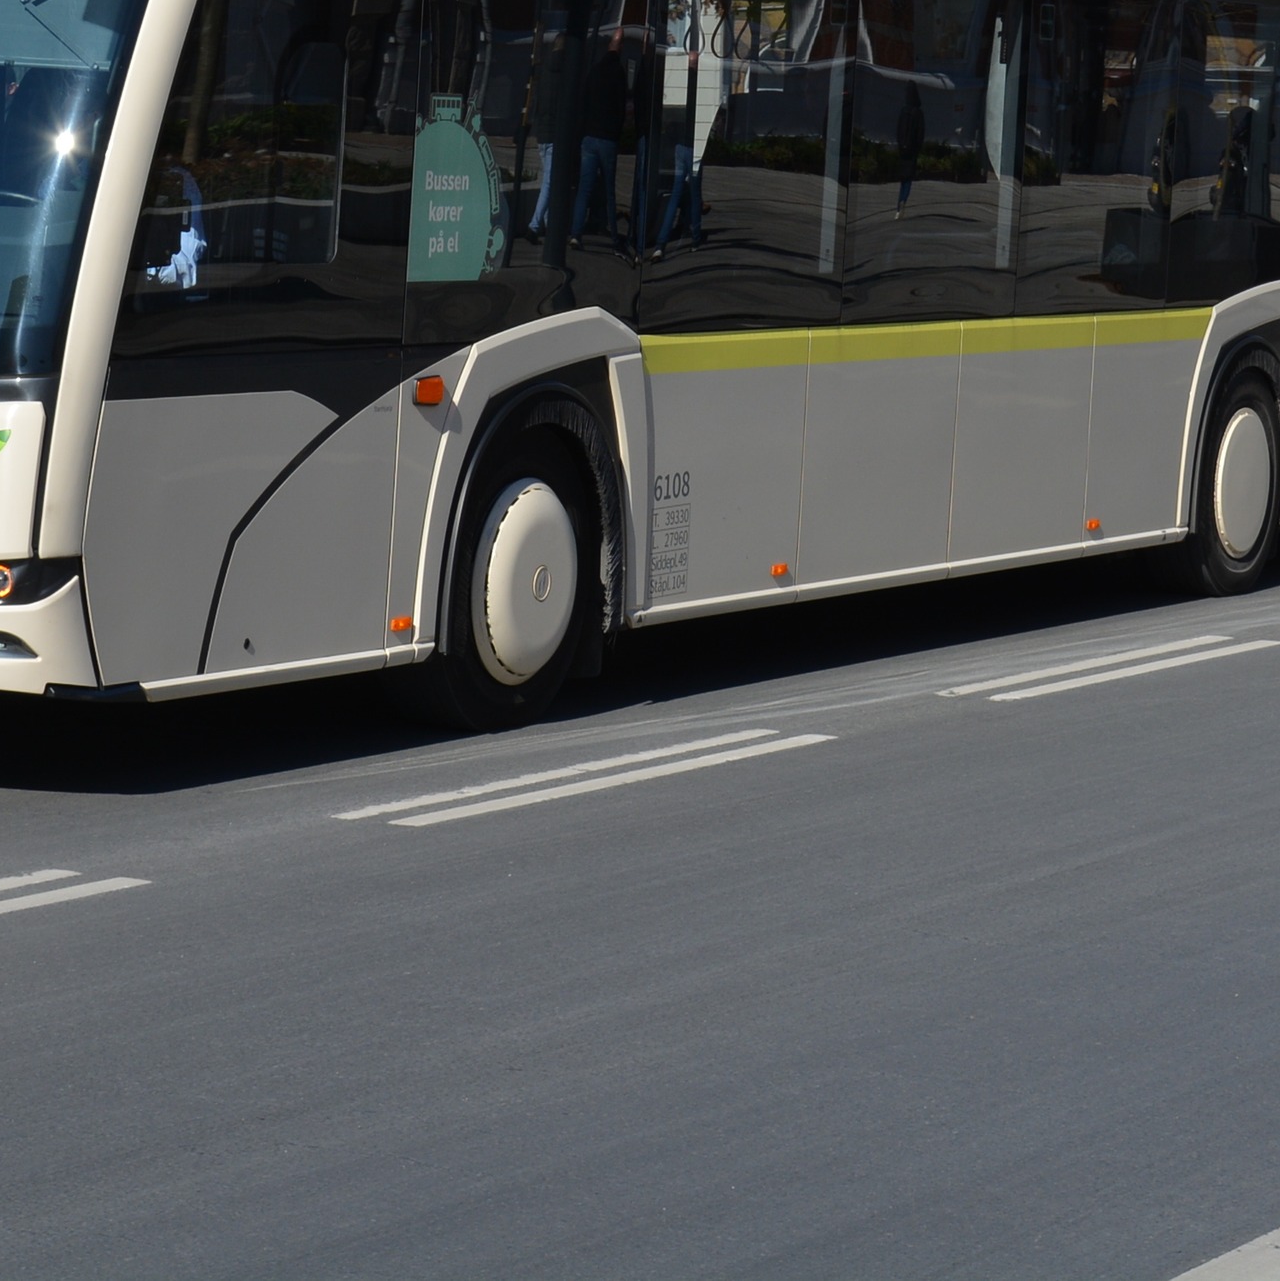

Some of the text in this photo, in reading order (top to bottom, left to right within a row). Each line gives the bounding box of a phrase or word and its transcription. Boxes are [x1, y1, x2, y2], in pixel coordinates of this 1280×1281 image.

[425, 170, 470, 191] Bussen
[428, 200, 463, 222] kører
[428, 230, 459, 258] på el
[654, 471, 690, 501] 6108
[664, 530, 688, 548] 27960
[678, 552, 687, 567] 49
[672, 574, 686, 590] 104
